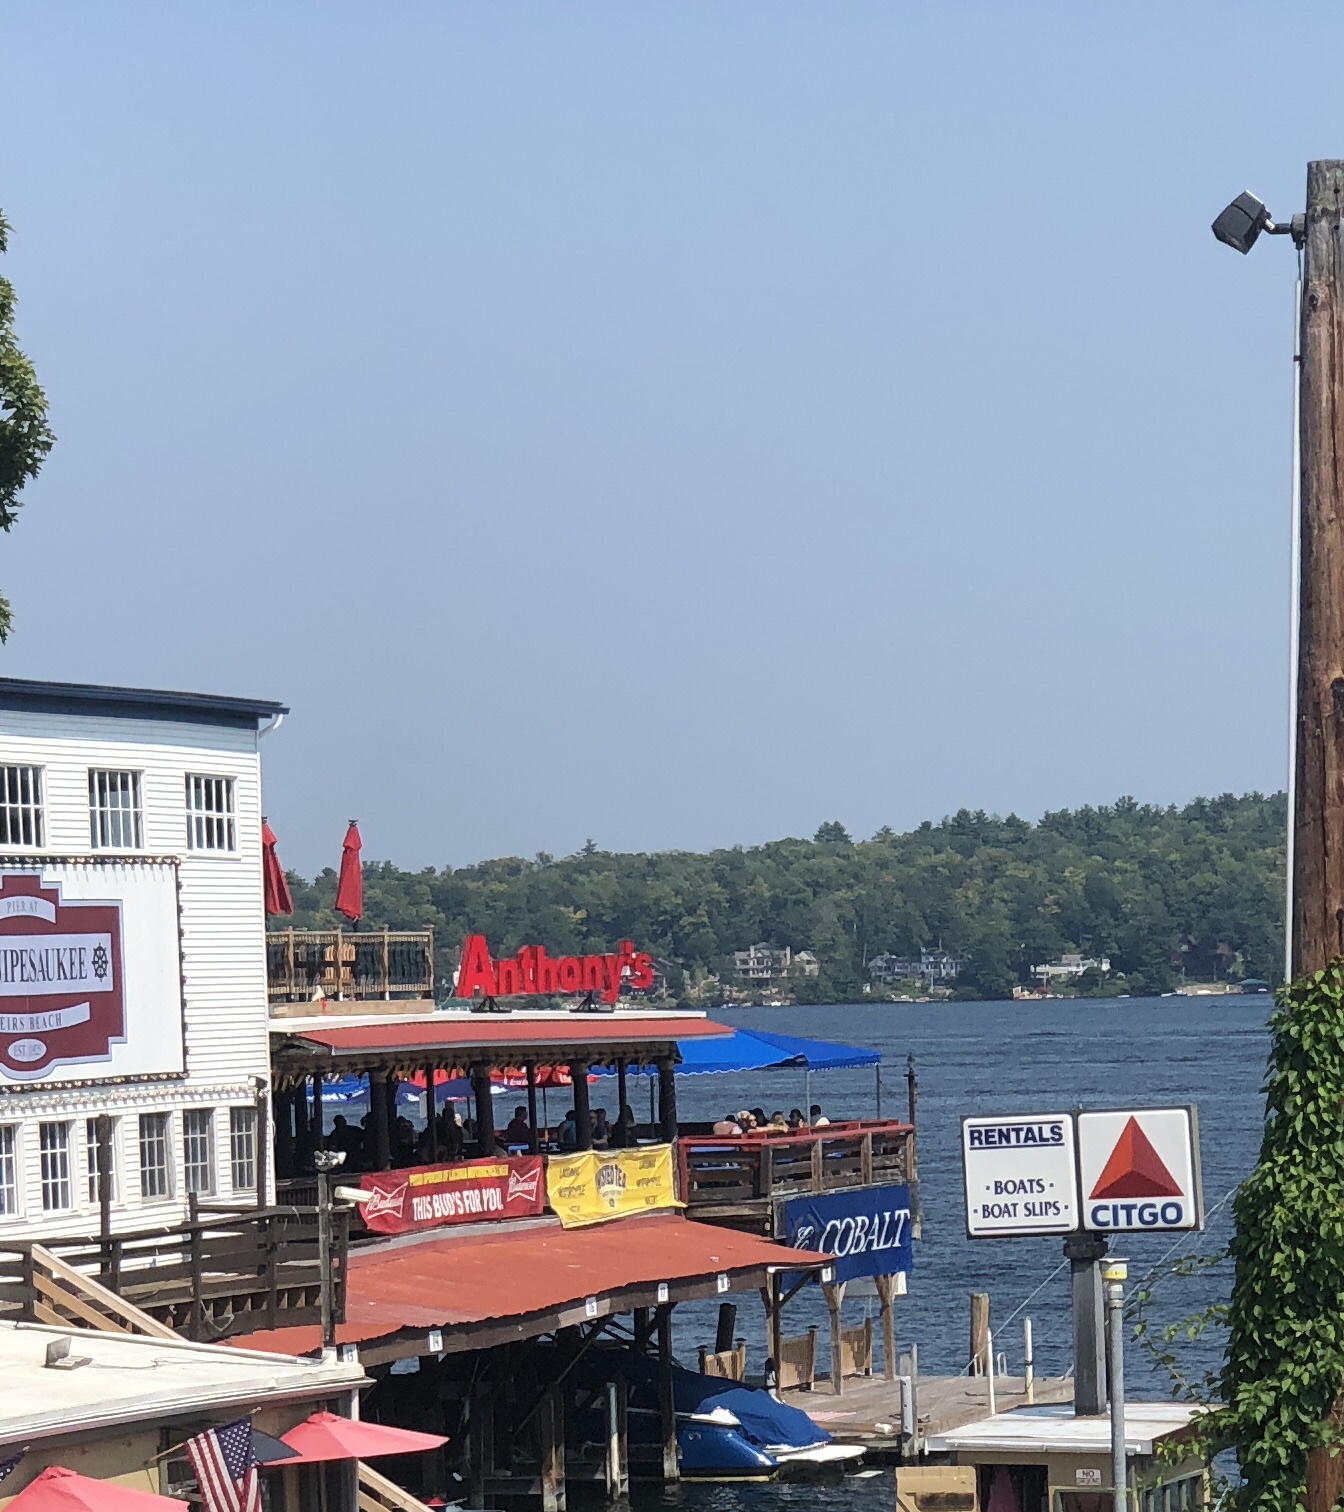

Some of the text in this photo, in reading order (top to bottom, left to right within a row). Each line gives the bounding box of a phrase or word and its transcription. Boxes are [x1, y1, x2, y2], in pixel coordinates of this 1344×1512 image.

[6, 901, 27, 914] PIER
[457, 934, 654, 1003] Anthony's
[30, 1012, 62, 1030] BEACH
[969, 1124, 1063, 1147] RENTALS
[993, 1178, 1045, 1196] BOATS
[413, 1195, 433, 1221] THIS
[433, 1190, 463, 1218] BUD'S
[463, 1188, 483, 1214] FOR
[981, 1200, 1062, 1219] BOAT SLIPS
[1090, 1201, 1184, 1228] CITGO
[818, 1208, 911, 1257] COBALT
